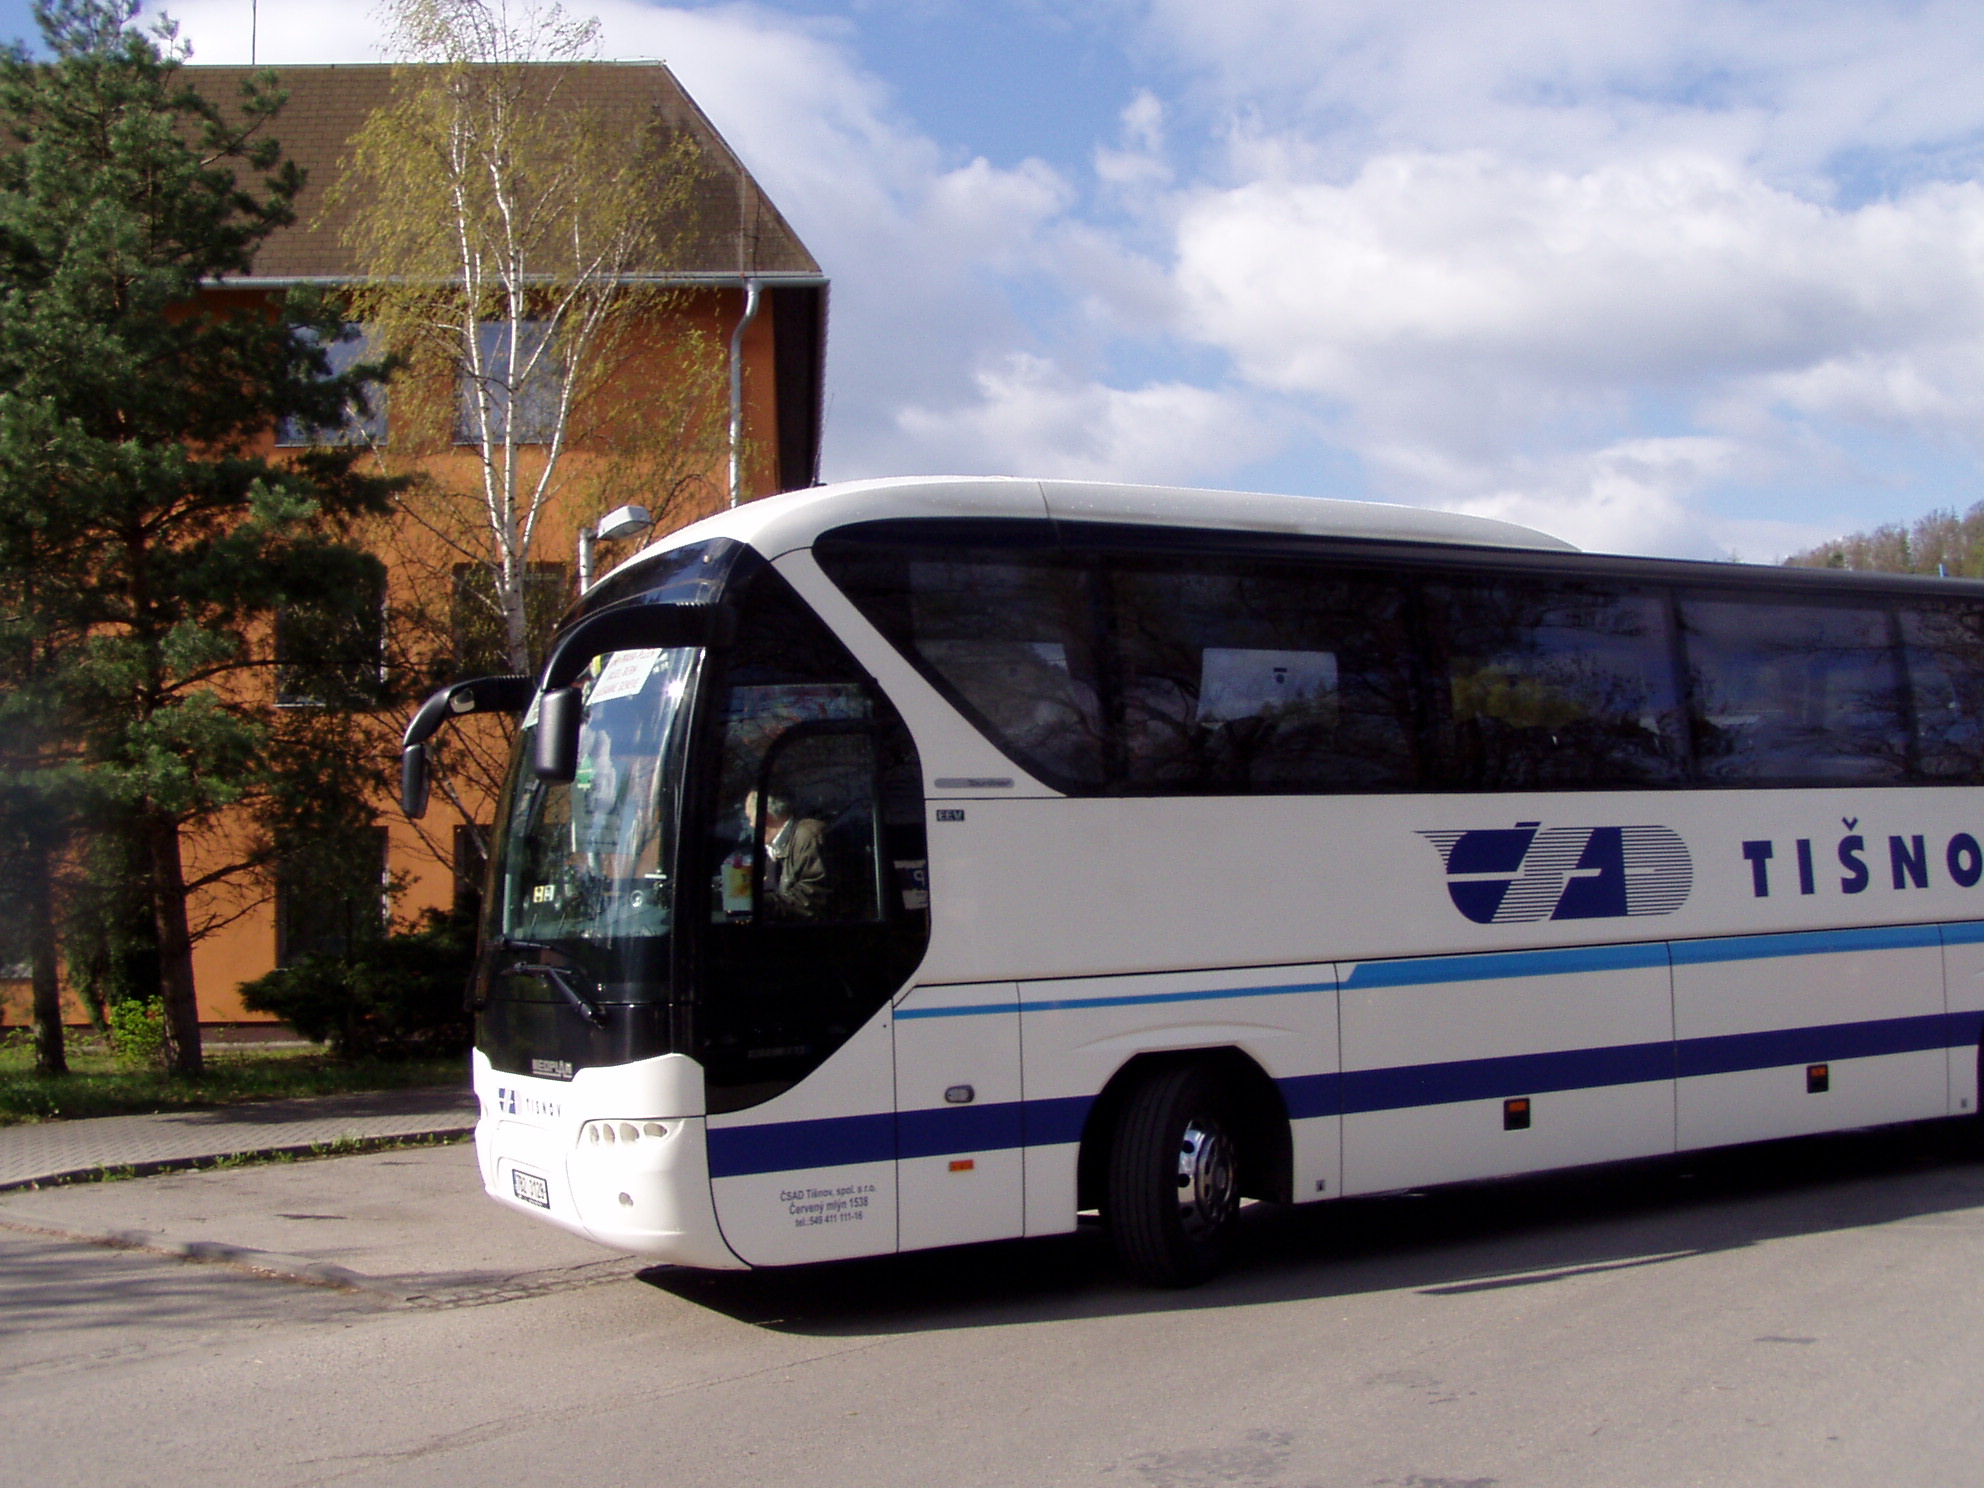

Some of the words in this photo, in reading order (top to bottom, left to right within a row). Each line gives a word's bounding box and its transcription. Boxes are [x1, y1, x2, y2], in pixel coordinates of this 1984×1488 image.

[938, 810, 963, 821] EEV
[1742, 817, 1983, 897] TIŠNO
[780, 1190, 804, 1202] ČSAD
[789, 1202, 824, 1215] Červený
[826, 1199, 847, 1213] mlýn
[849, 1196, 869, 1208] 1538
